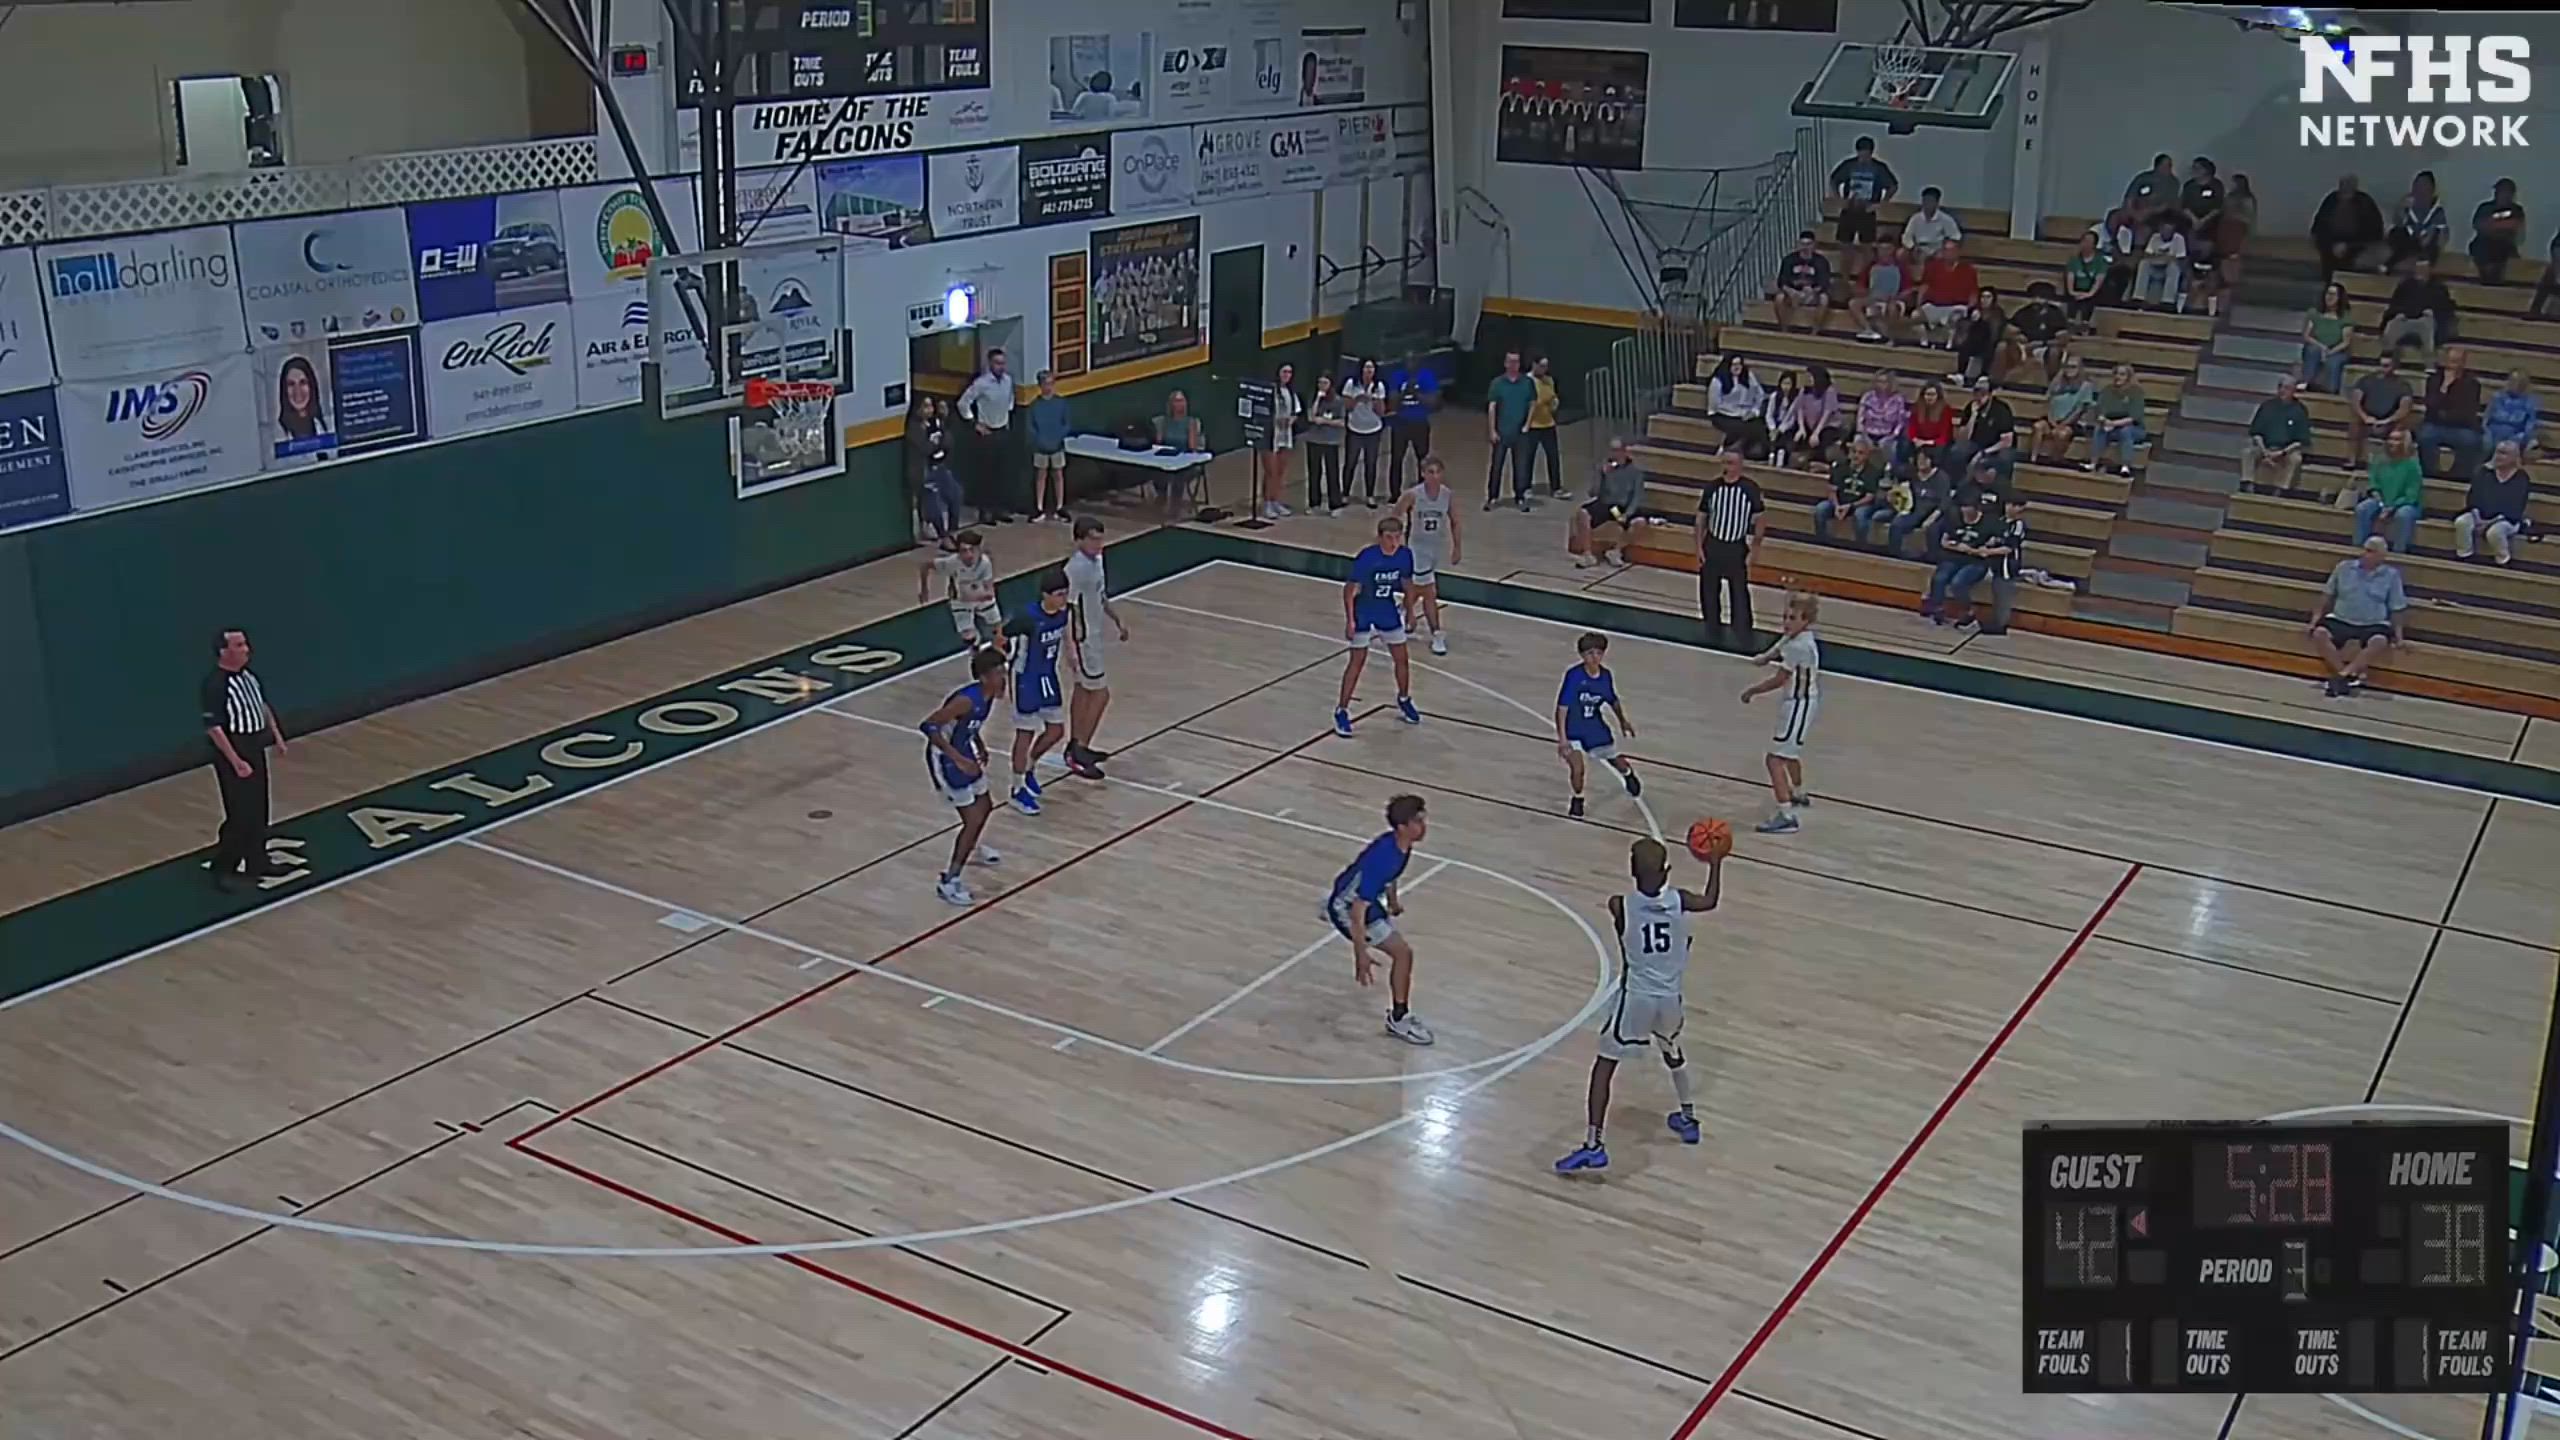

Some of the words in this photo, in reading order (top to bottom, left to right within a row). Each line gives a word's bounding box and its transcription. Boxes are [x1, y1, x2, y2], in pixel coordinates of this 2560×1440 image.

[801, 10, 850, 28] PERIOD
[793, 56, 823, 71] TIME
[866, 52, 893, 67] TE
[949, 48, 977, 62] TEAM
[794, 72, 825, 87] OUTS
[949, 62, 981, 78] FOULS
[753, 104, 827, 130] HOME
[843, 100, 870, 123] OF
[885, 96, 932, 119] THE
[2024, 64, 2040, 151] HOME
[775, 122, 915, 160] FALCONS
[1216, 130, 1262, 153] GROVE
[1124, 153, 1181, 175] OnPlace
[947, 199, 1003, 217] NORTHERN
[962, 215, 993, 229] TRUST
[247, 281, 312, 301] COASTAL
[315, 269, 409, 291] ORTHOPEDICS
[442, 321, 556, 375] enRich
[587, 342, 617, 357] AIR
[621, 339, 630, 351] &
[633, 328, 693, 349] ERGY
[106, 384, 179, 422] IMS
[1641, 922, 1671, 954] 15
